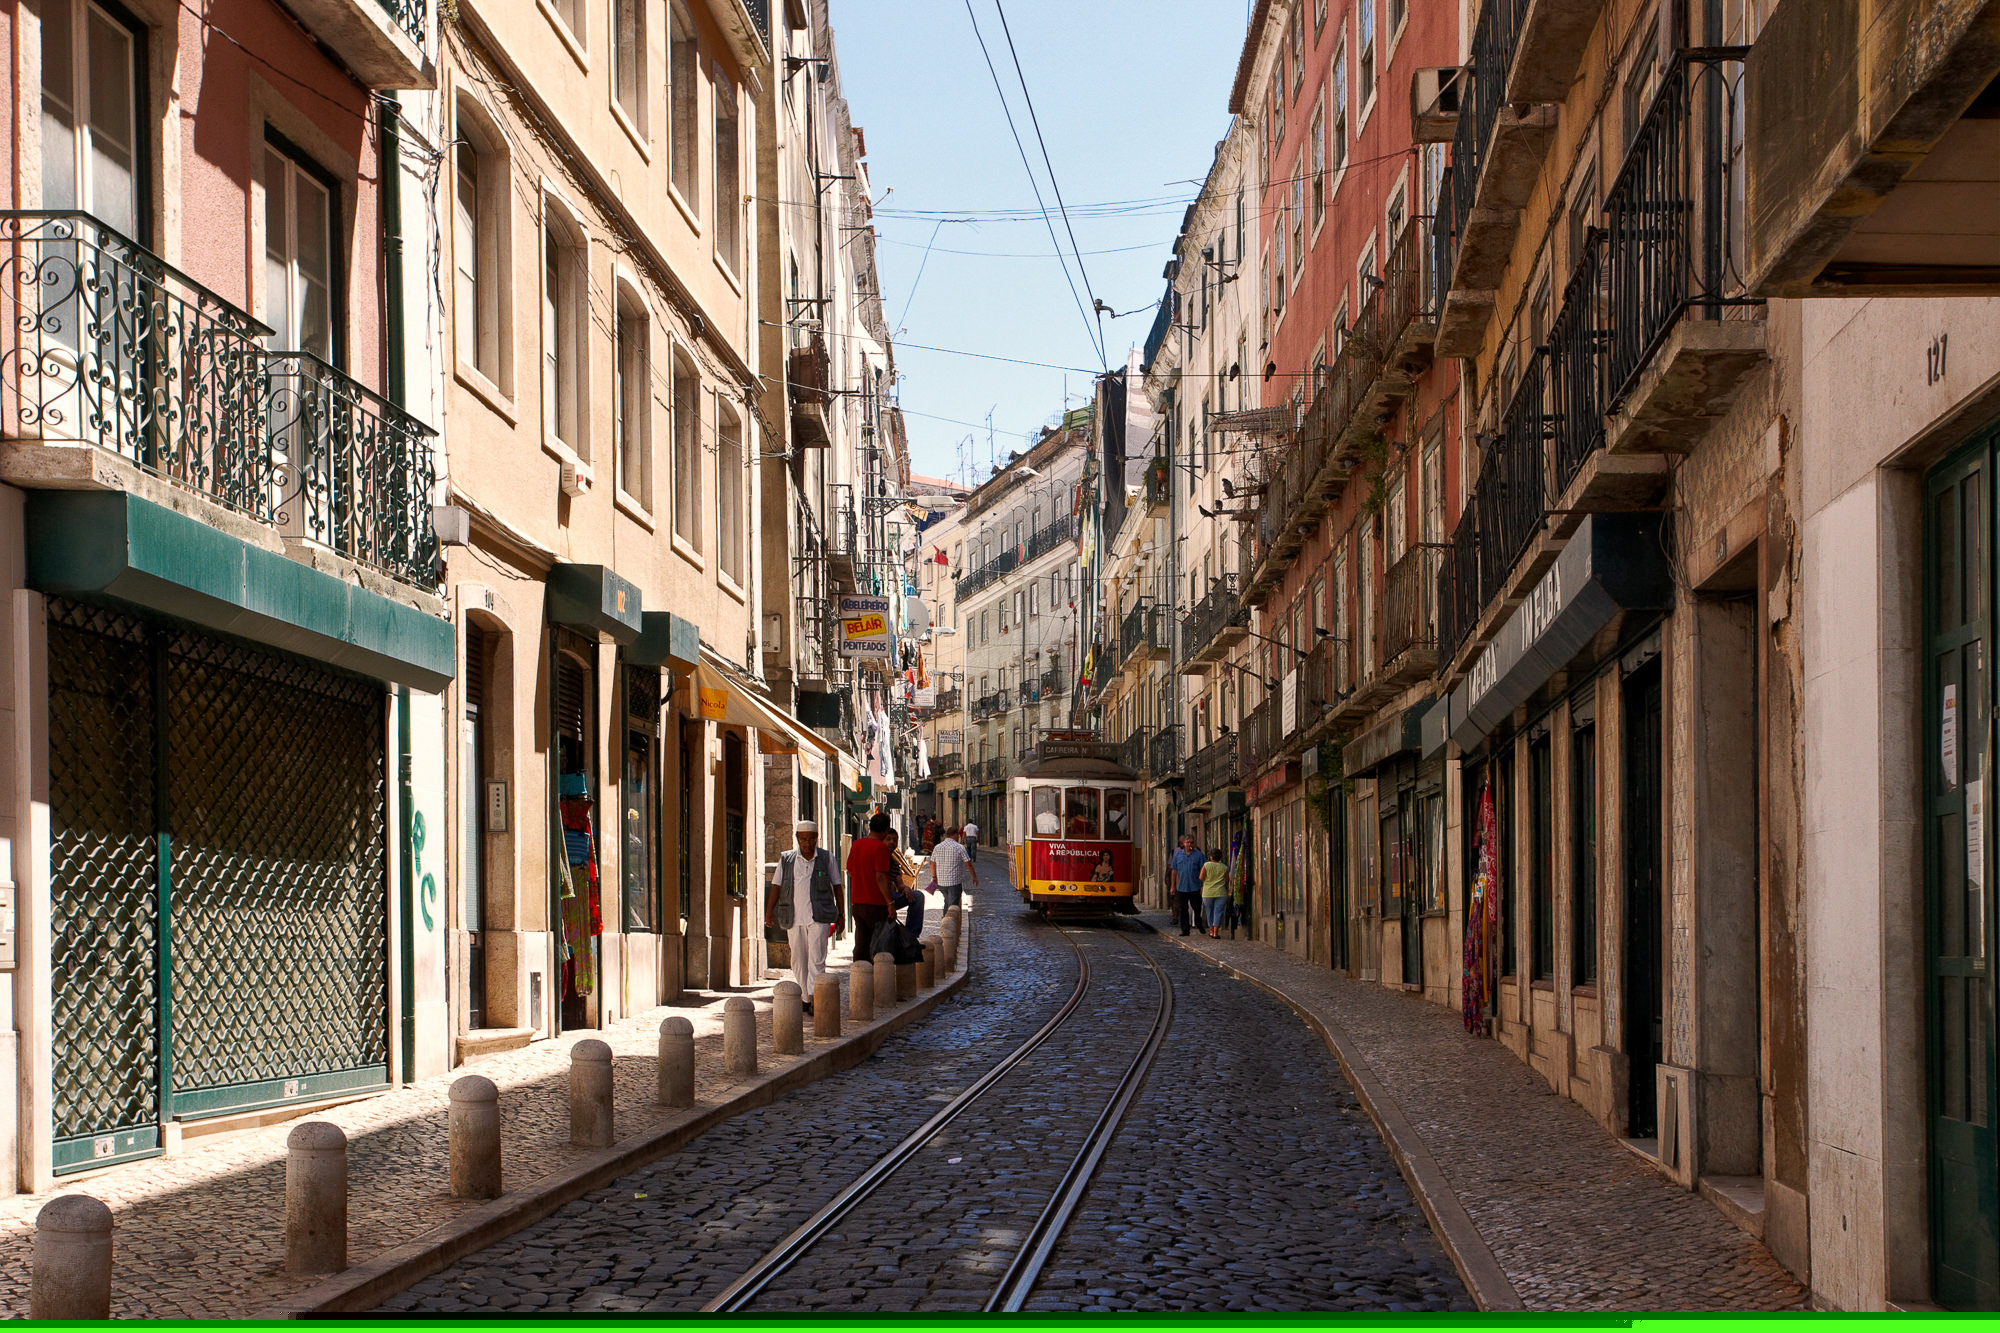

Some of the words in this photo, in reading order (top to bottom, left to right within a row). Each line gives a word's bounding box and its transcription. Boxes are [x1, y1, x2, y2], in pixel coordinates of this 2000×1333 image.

[843, 641, 886, 652] PENTEADOS
[700, 697, 726, 710] Nicola
[1045, 746, 1079, 754] CARREIRA
[1056, 848, 1100, 858] REPÚBLICA!
